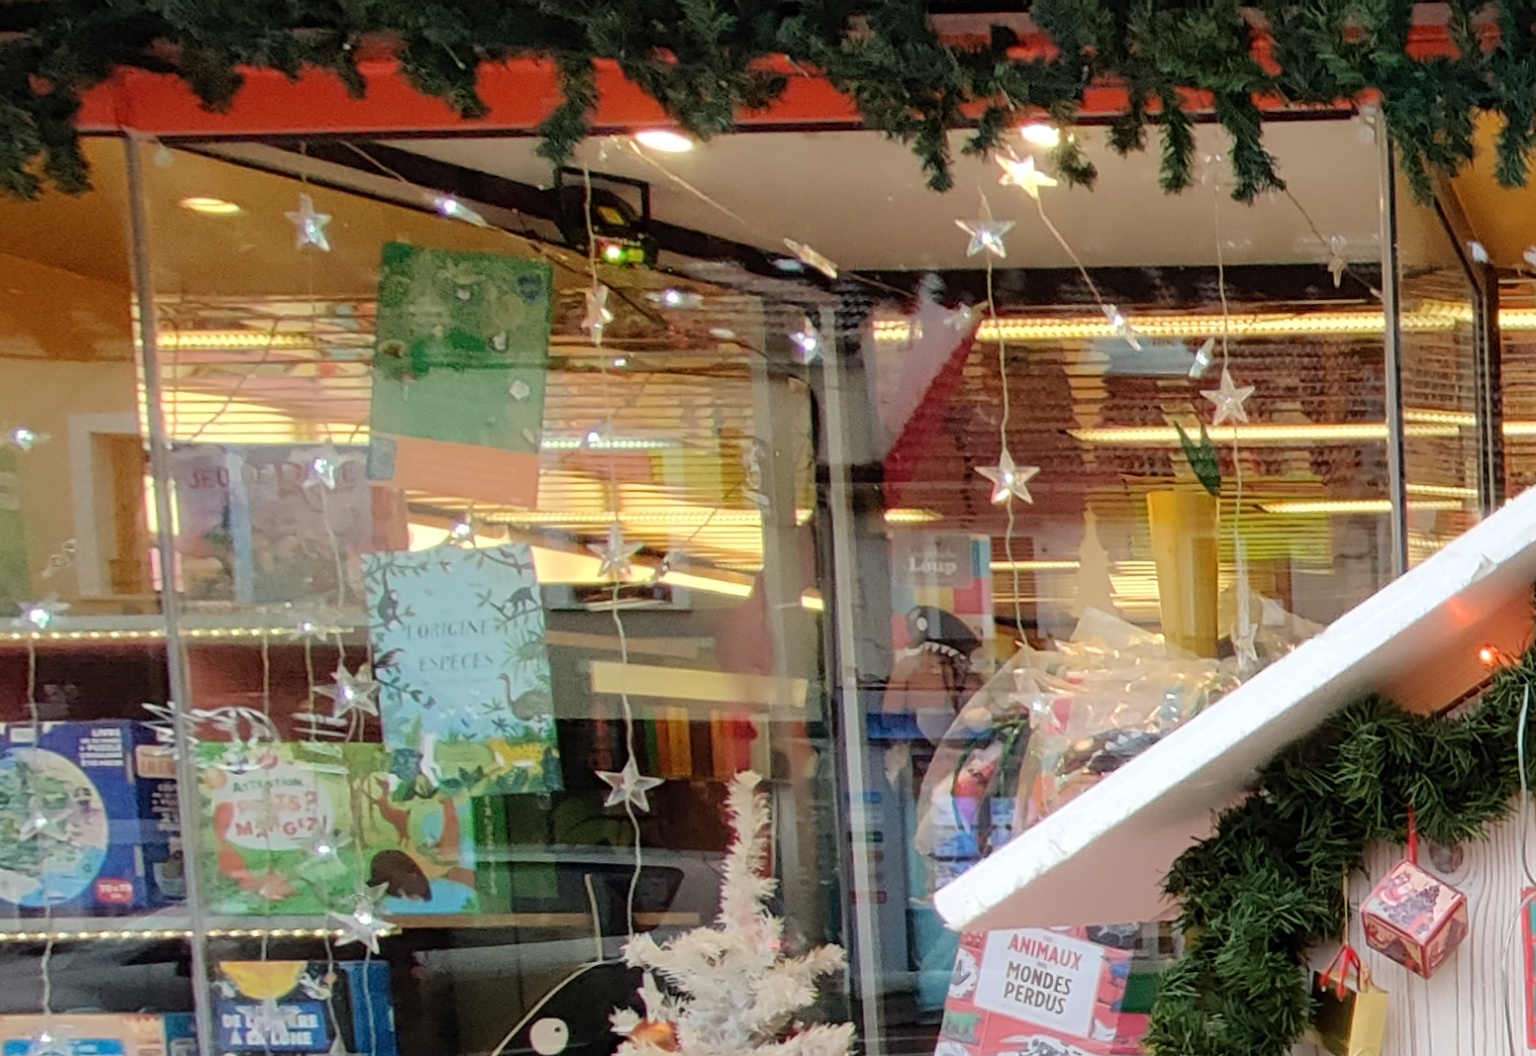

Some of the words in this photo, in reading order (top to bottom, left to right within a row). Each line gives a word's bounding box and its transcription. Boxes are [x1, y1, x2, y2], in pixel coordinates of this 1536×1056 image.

[909, 556, 958, 577] Loup
[1007, 932, 1083, 972] ANIMAUX
[1005, 960, 1073, 996] MONDES
[1002, 981, 1067, 1016] PERDUS
